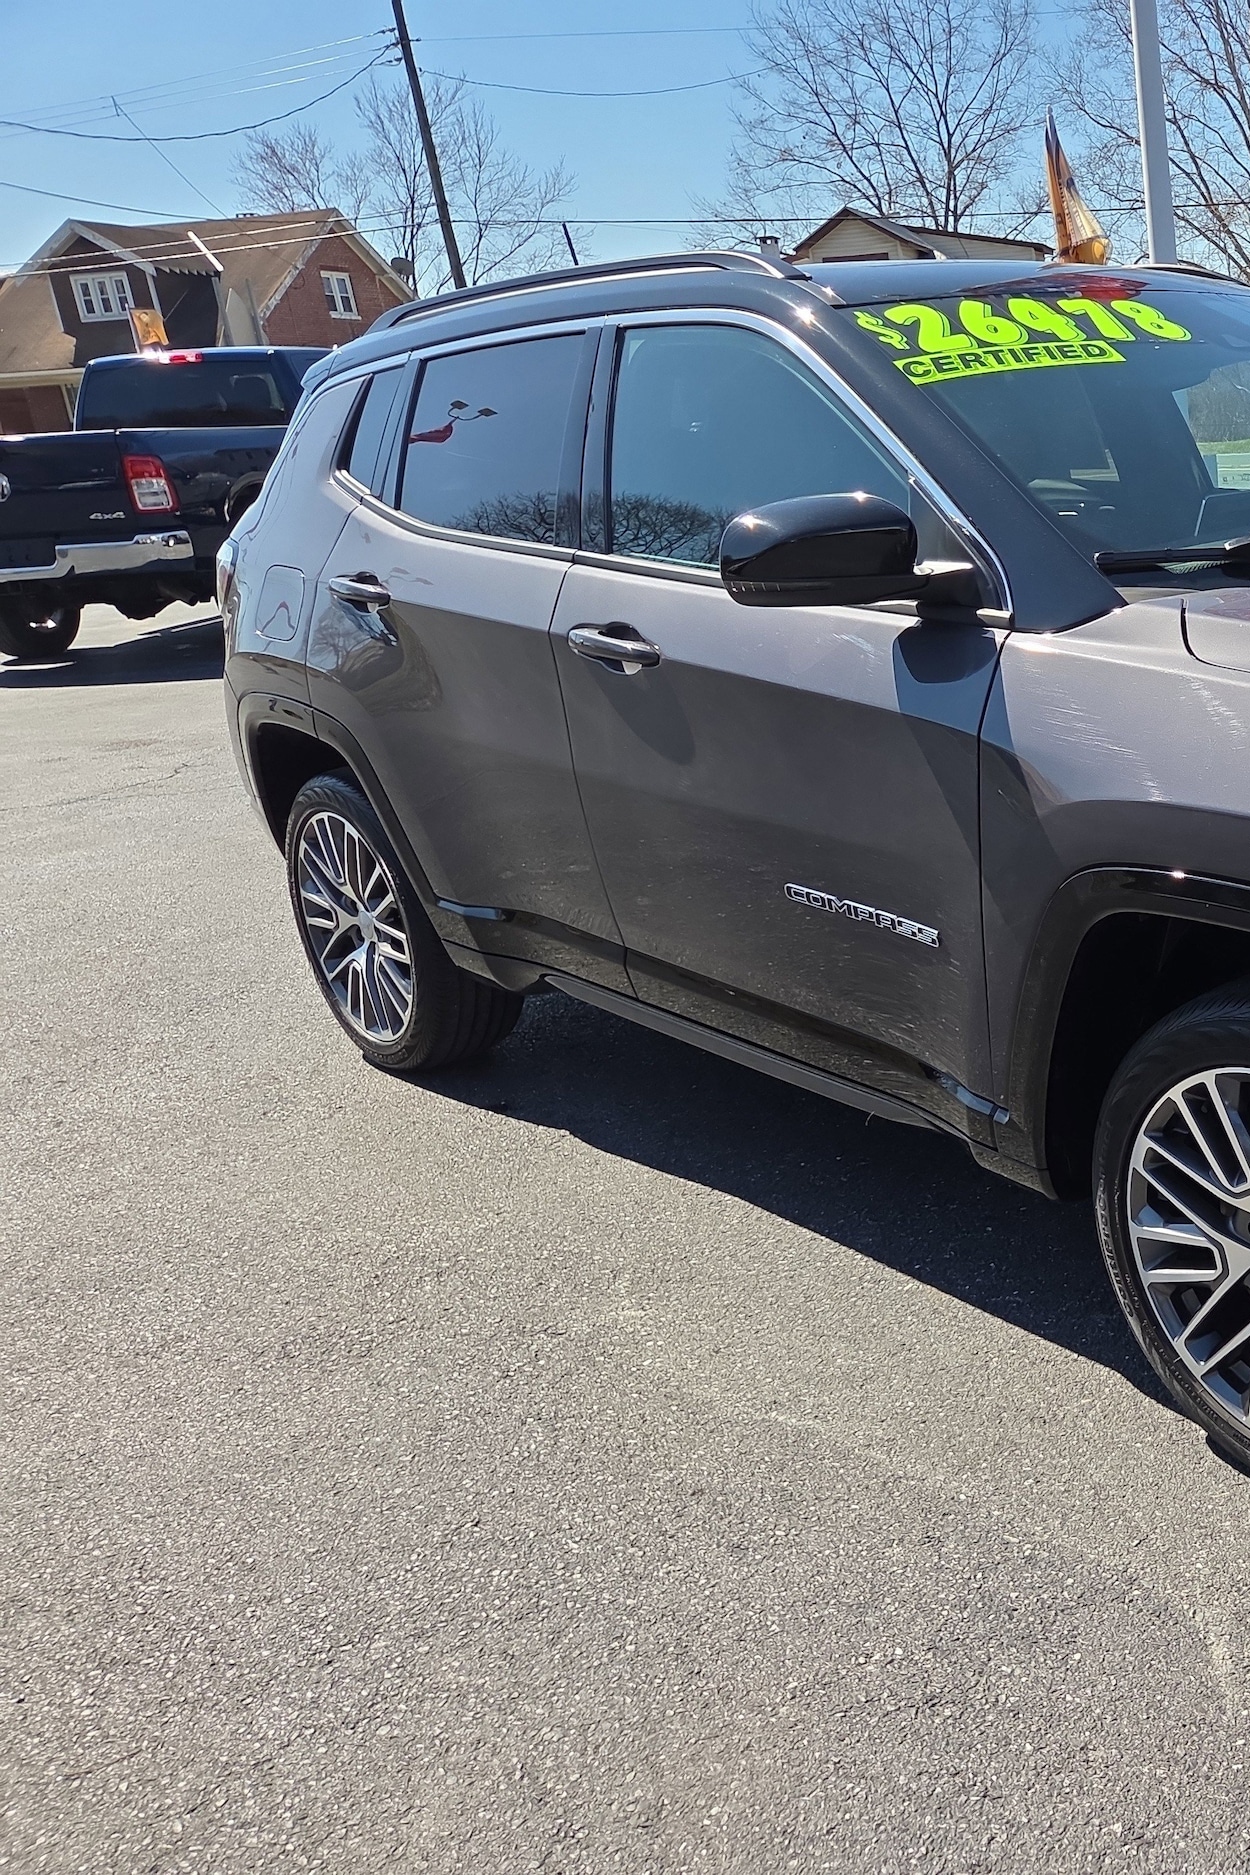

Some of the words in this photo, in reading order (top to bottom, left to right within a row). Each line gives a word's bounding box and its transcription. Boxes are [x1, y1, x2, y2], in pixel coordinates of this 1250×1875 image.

[854, 298, 1192, 352] $26478
[900, 342, 1113, 379] CERTIFIED
[784, 882, 940, 948] COMPASS
